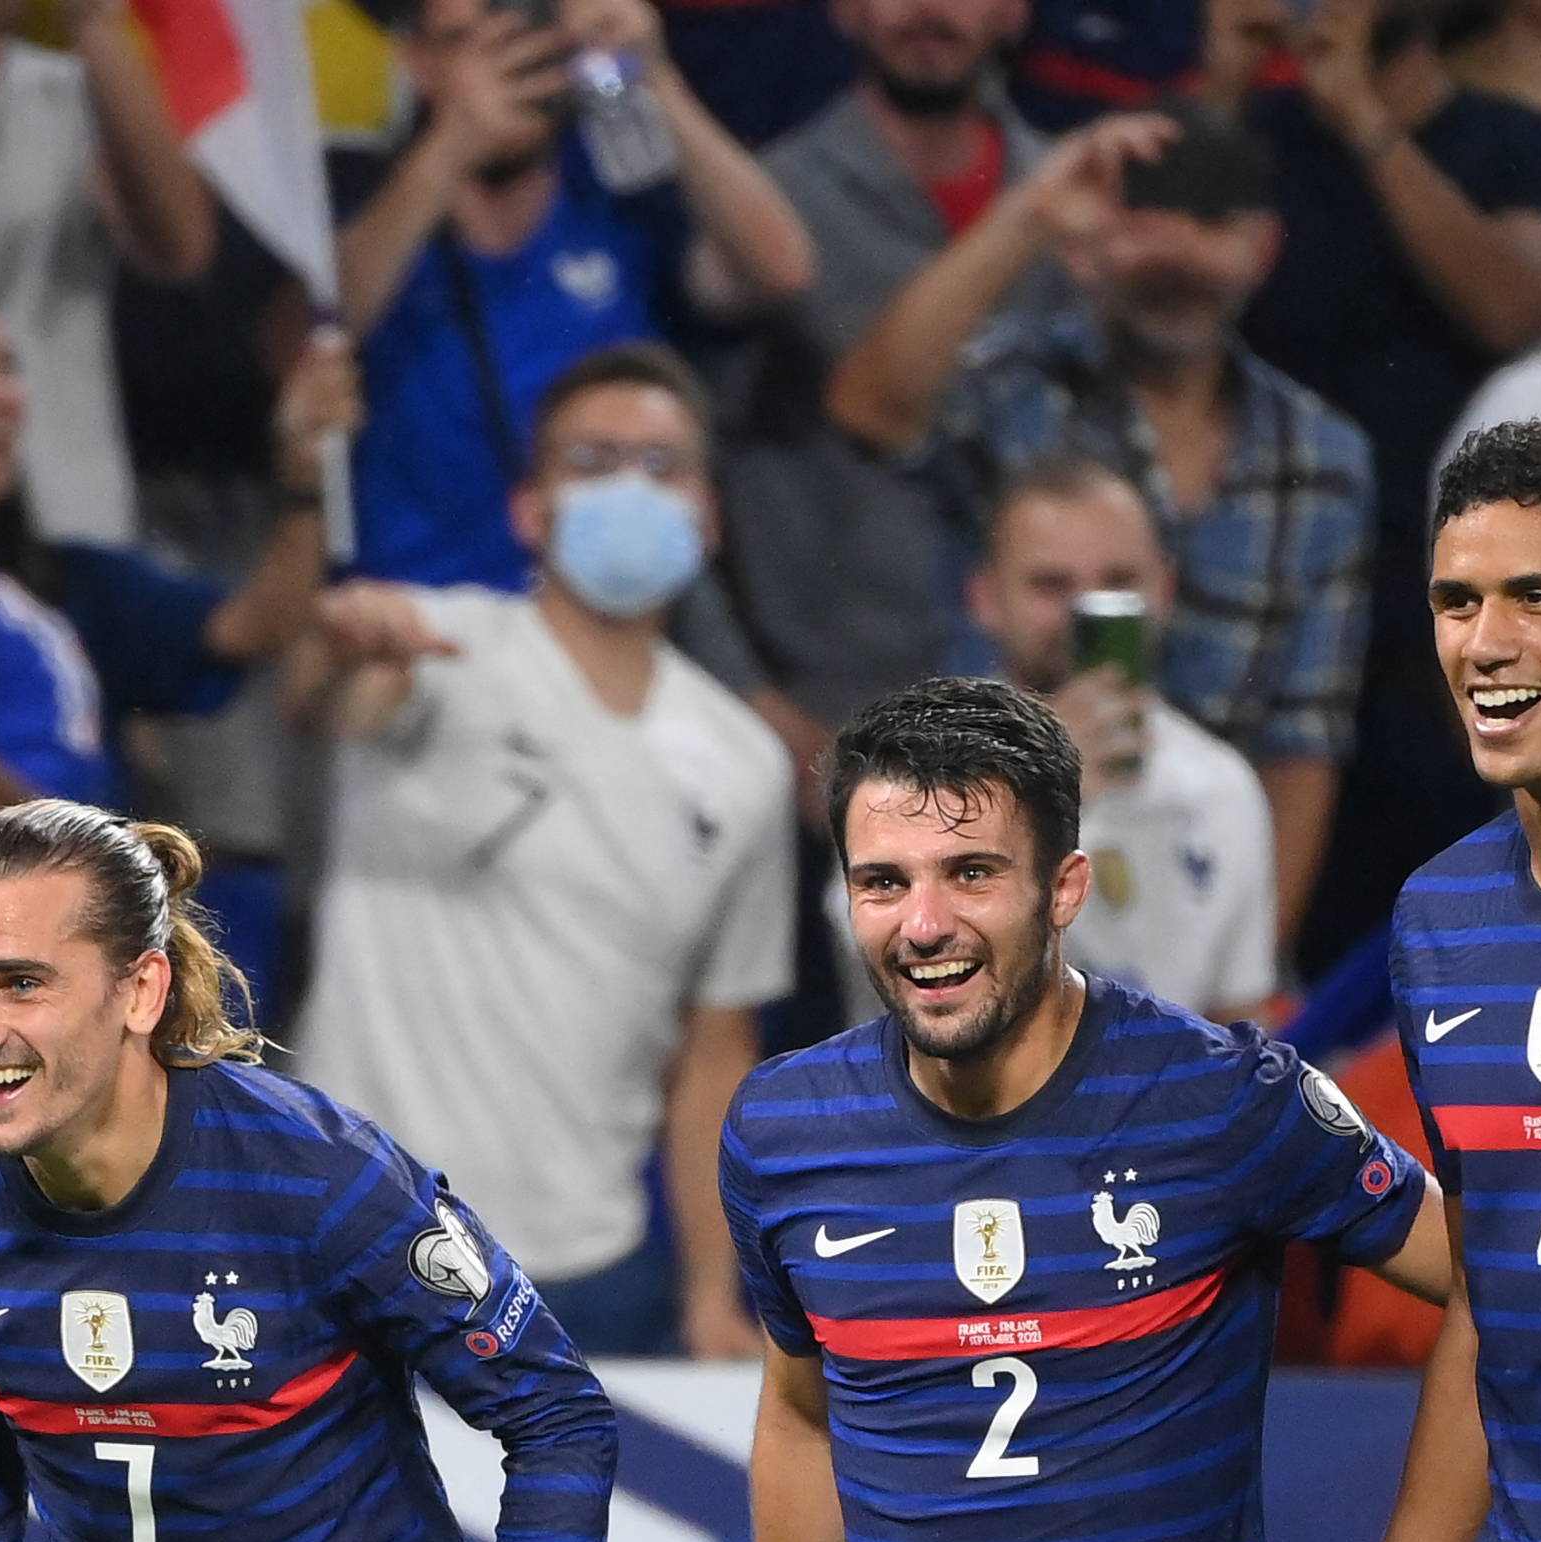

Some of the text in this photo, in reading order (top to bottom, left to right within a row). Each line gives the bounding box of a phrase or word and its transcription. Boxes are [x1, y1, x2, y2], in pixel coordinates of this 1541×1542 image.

[977, 1265, 1006, 1276] FIFA
[958, 1322, 991, 1336] FRANCE
[999, 1319, 1042, 1334] FINLANDE
[958, 1334, 966, 1347] 7
[1017, 1329, 1043, 1344] 2021
[84, 1354, 114, 1367] FIFA
[966, 1356, 1039, 1478] 2
